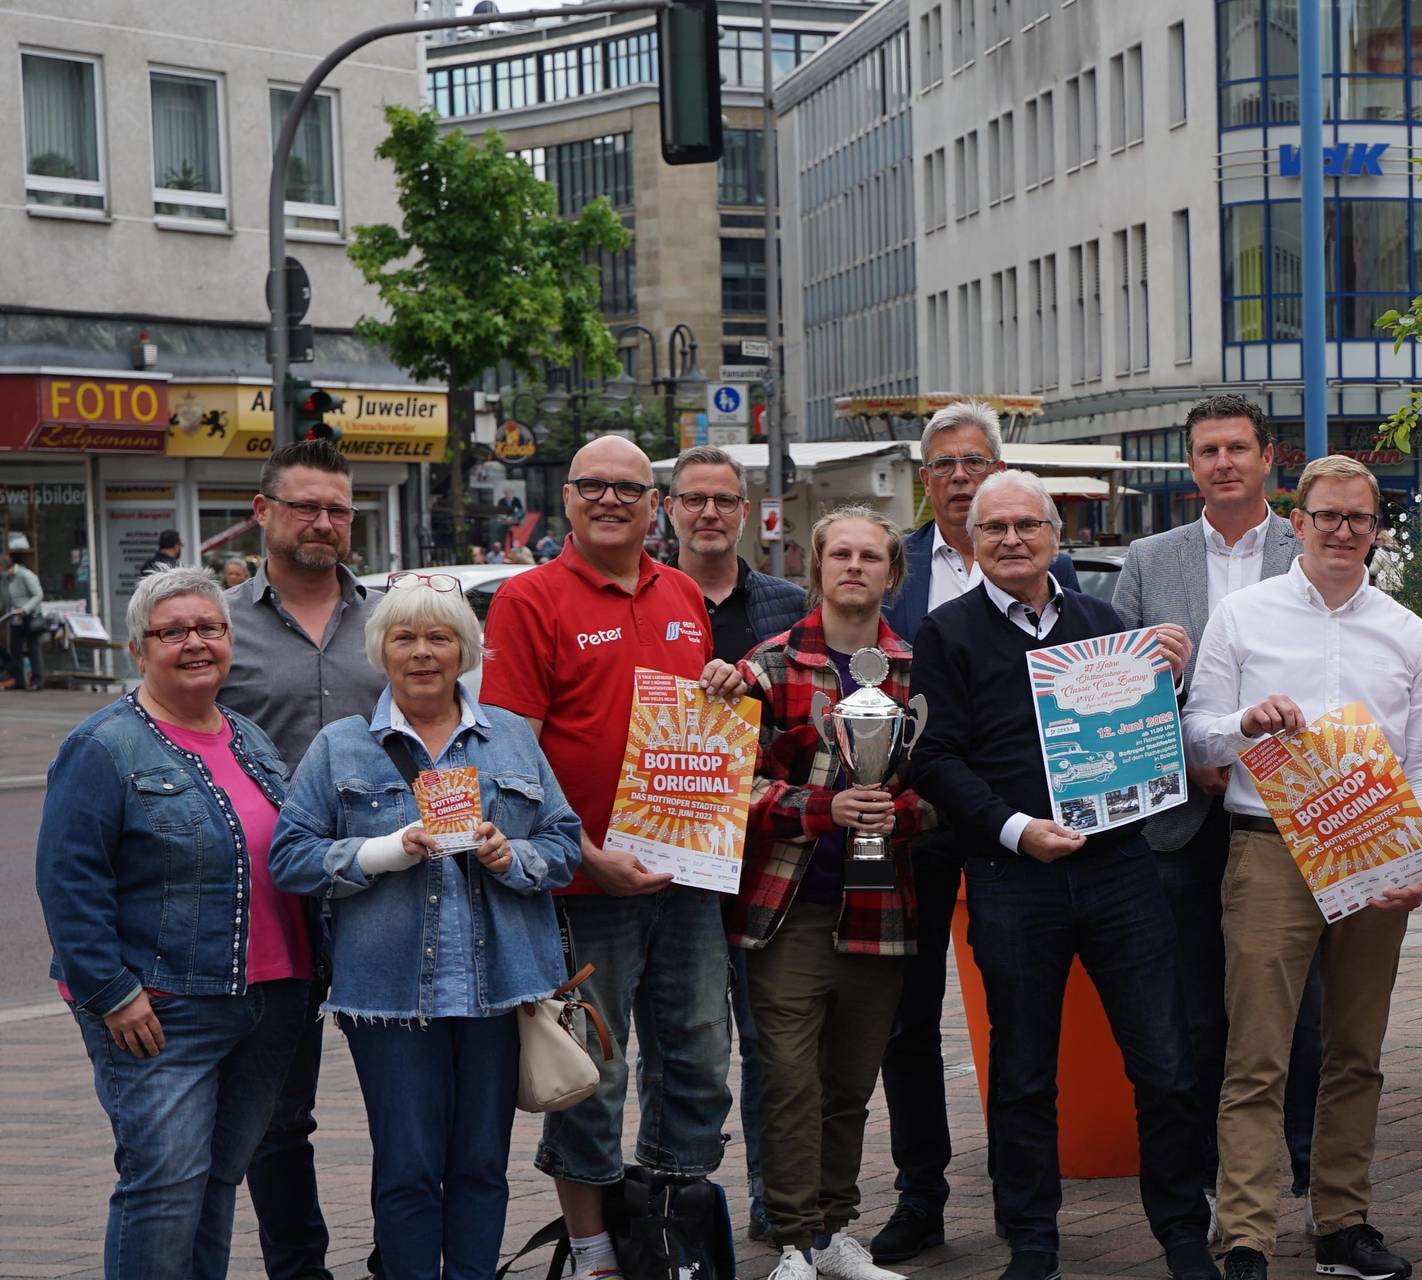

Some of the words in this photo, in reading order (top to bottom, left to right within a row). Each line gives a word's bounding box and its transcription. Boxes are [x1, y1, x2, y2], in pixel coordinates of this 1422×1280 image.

[1279, 143, 1391, 177] VdK
[51, 381, 159, 422] FOTO
[356, 395, 437, 420] Juwelier
[246, 437, 434, 456] GOAHMESTELLE
[577, 627, 622, 650] Peter
[1061, 683, 1090, 698] Classic
[1093, 679, 1114, 692] Cars
[1097, 726, 1116, 739] 12.
[1117, 719, 1144, 735] Juni
[1145, 711, 1174, 727] 2022
[1164, 723, 1175, 733] Uhr
[644, 752, 723, 772] BOTTROP
[653, 775, 734, 793] ORIGINAL
[430, 793, 465, 809] BOTTROP
[437, 801, 473, 816] ORIGINAL
[631, 792, 646, 801] DAS
[647, 794, 690, 808] BOTTROPER
[691, 801, 731, 813] STADTFEST
[1295, 770, 1367, 827] BOTTROP
[1317, 782, 1392, 836] ORIGINAL
[651, 805, 662, 813] 10.
[667, 807, 677, 815] 12.
[677, 809, 694, 818] JUNI
[695, 812, 713, 821] 2022
[1308, 844, 1325, 858] DAS
[1324, 826, 1364, 848] BOTTROPER
[1363, 804, 1400, 829] STADTFEST
[1333, 844, 1345, 853] 10.
[1348, 838, 1358, 847] 12.
[1356, 830, 1373, 844] JUNI
[1372, 822, 1391, 836] 2022
